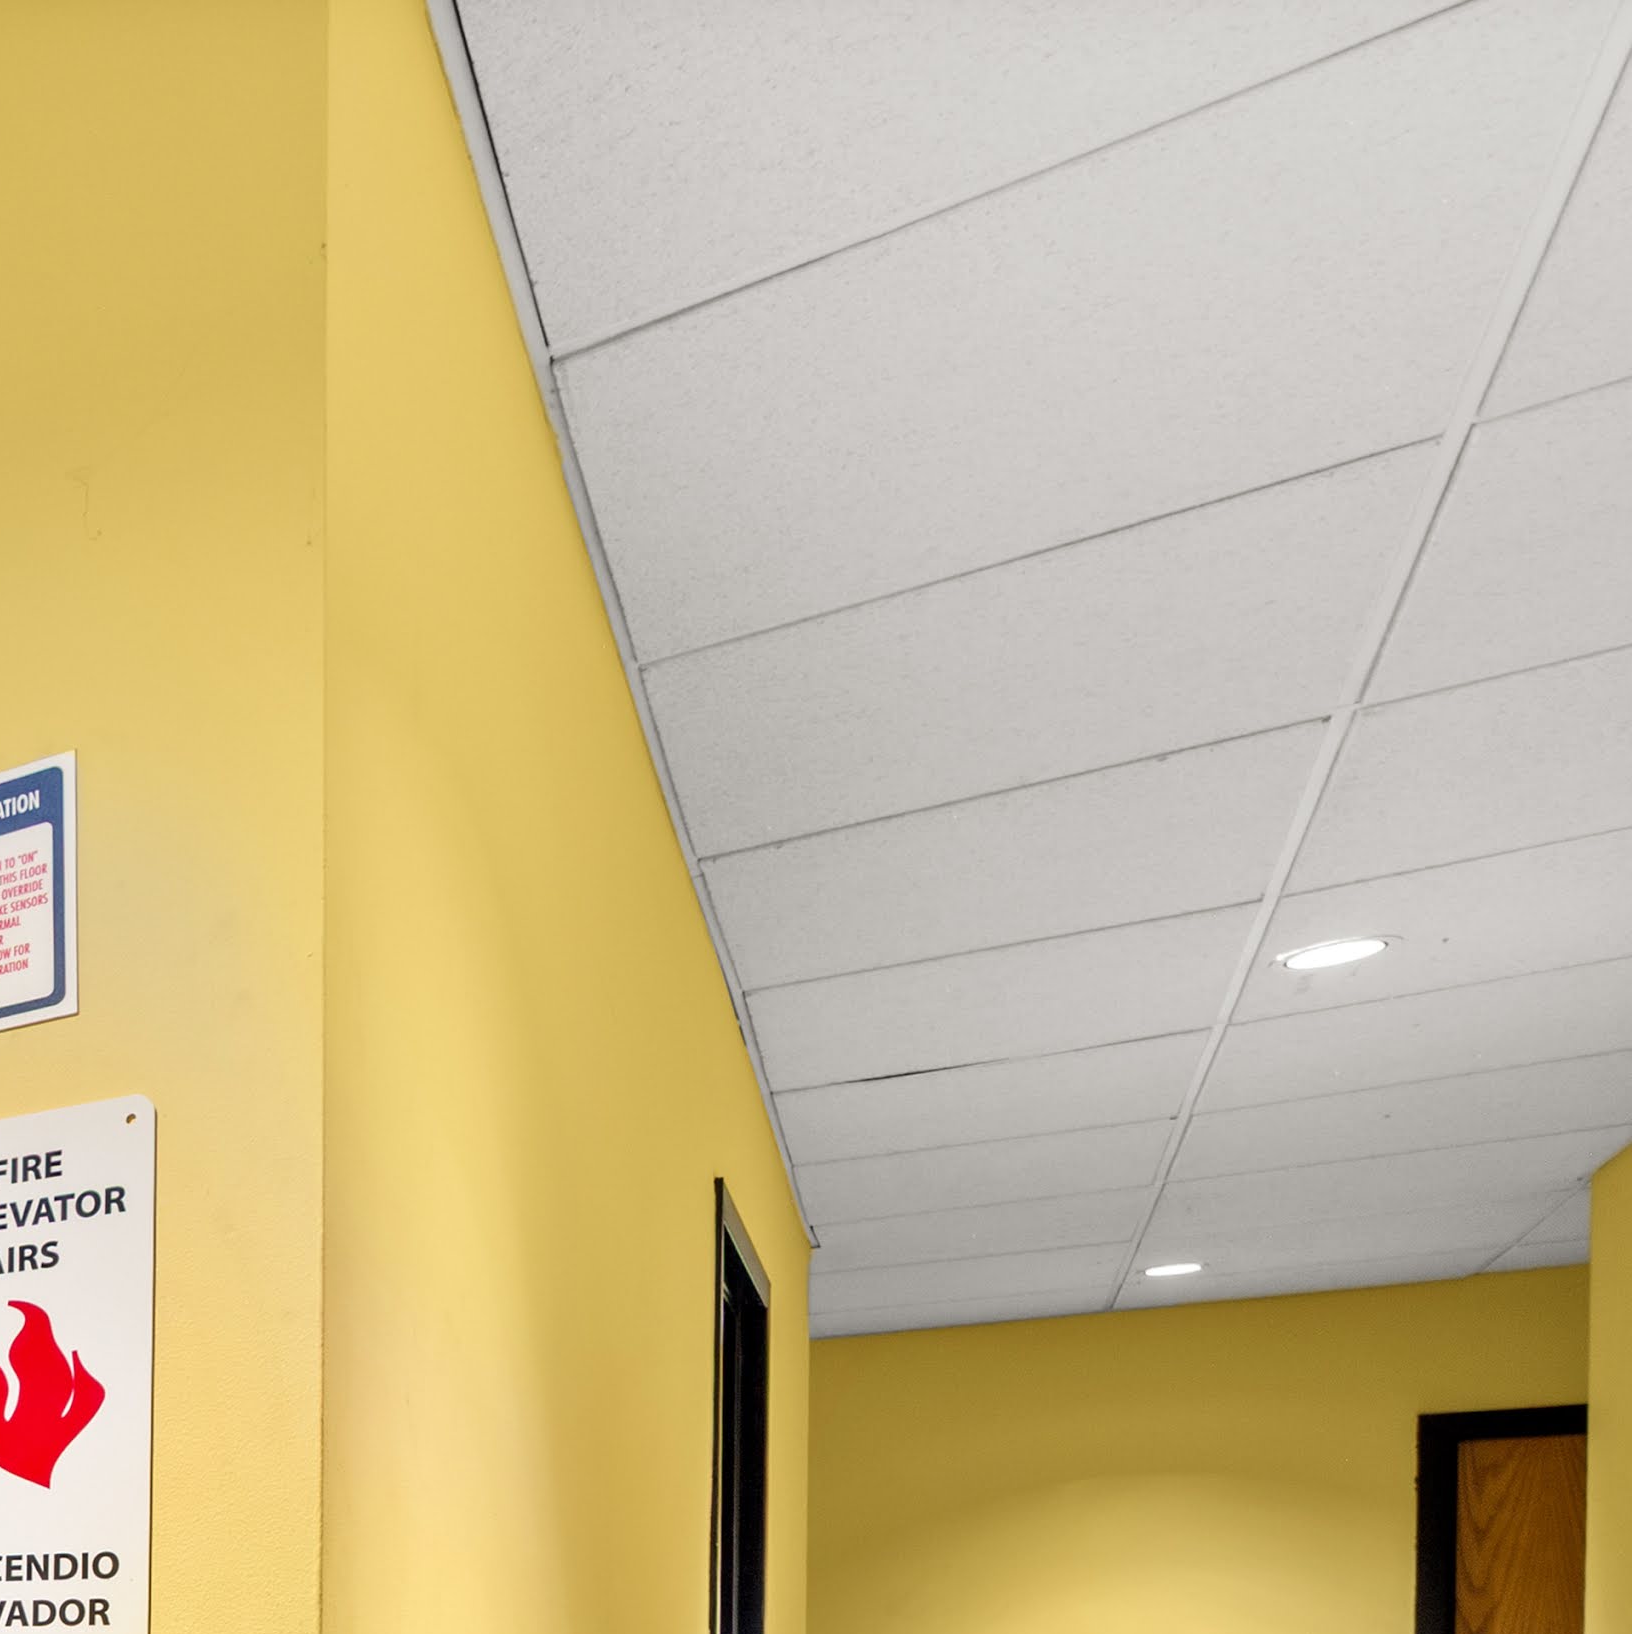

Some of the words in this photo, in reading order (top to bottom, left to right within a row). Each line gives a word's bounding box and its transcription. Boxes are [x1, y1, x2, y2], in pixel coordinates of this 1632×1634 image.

[5, 858, 15, 868] TO
[0, 871, 17, 884] THIS
[20, 863, 48, 879] FLOOR
[2, 879, 43, 899] OVERRIDE
[11, 893, 48, 912] SENSORS
[14, 943, 30, 955] FOR
